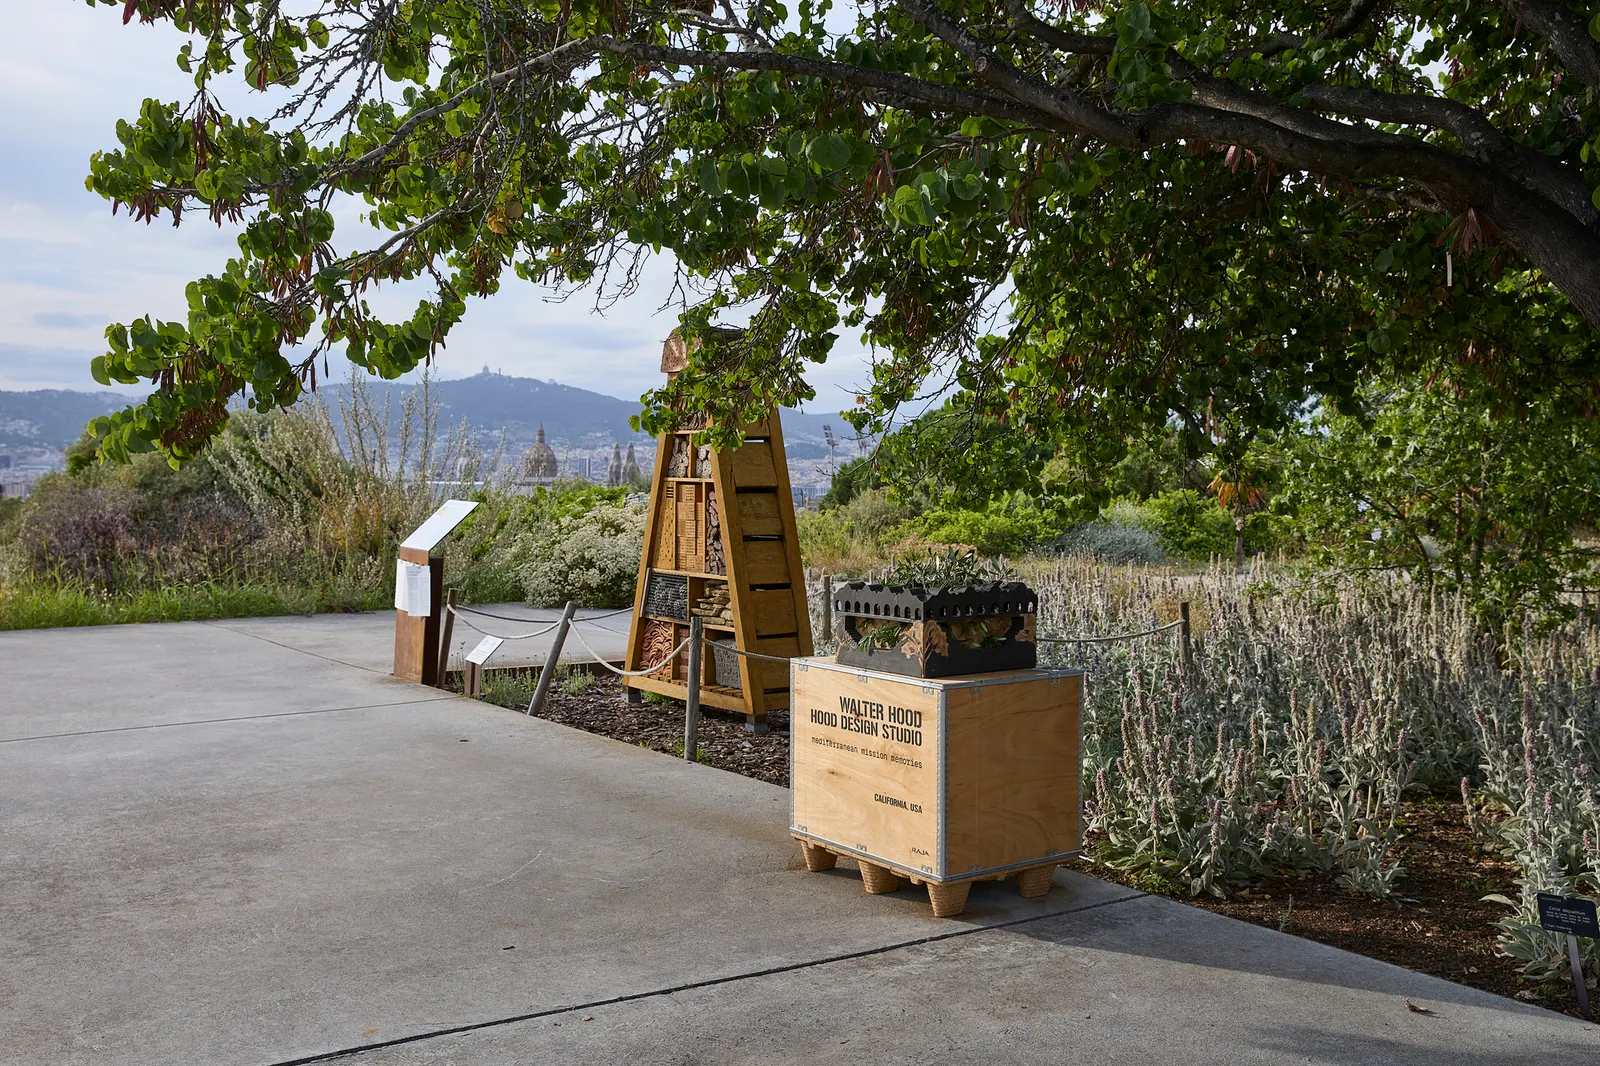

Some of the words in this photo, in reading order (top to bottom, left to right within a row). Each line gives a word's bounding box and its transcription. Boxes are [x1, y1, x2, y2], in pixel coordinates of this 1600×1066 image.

[810, 708, 837, 728] HOOD
[841, 716, 879, 737] DESIGN
[882, 723, 923, 747] STUDIO
[839, 695, 884, 721] WALTER
[888, 706, 923, 729] HOOD
[811, 736, 858, 753] mediterranean
[860, 746, 888, 761] mission
[890, 754, 923, 769] memories
[874, 793, 909, 811] CALIFORNIA,
[910, 803, 923, 814] USA
[911, 847, 929, 856] RAJA
